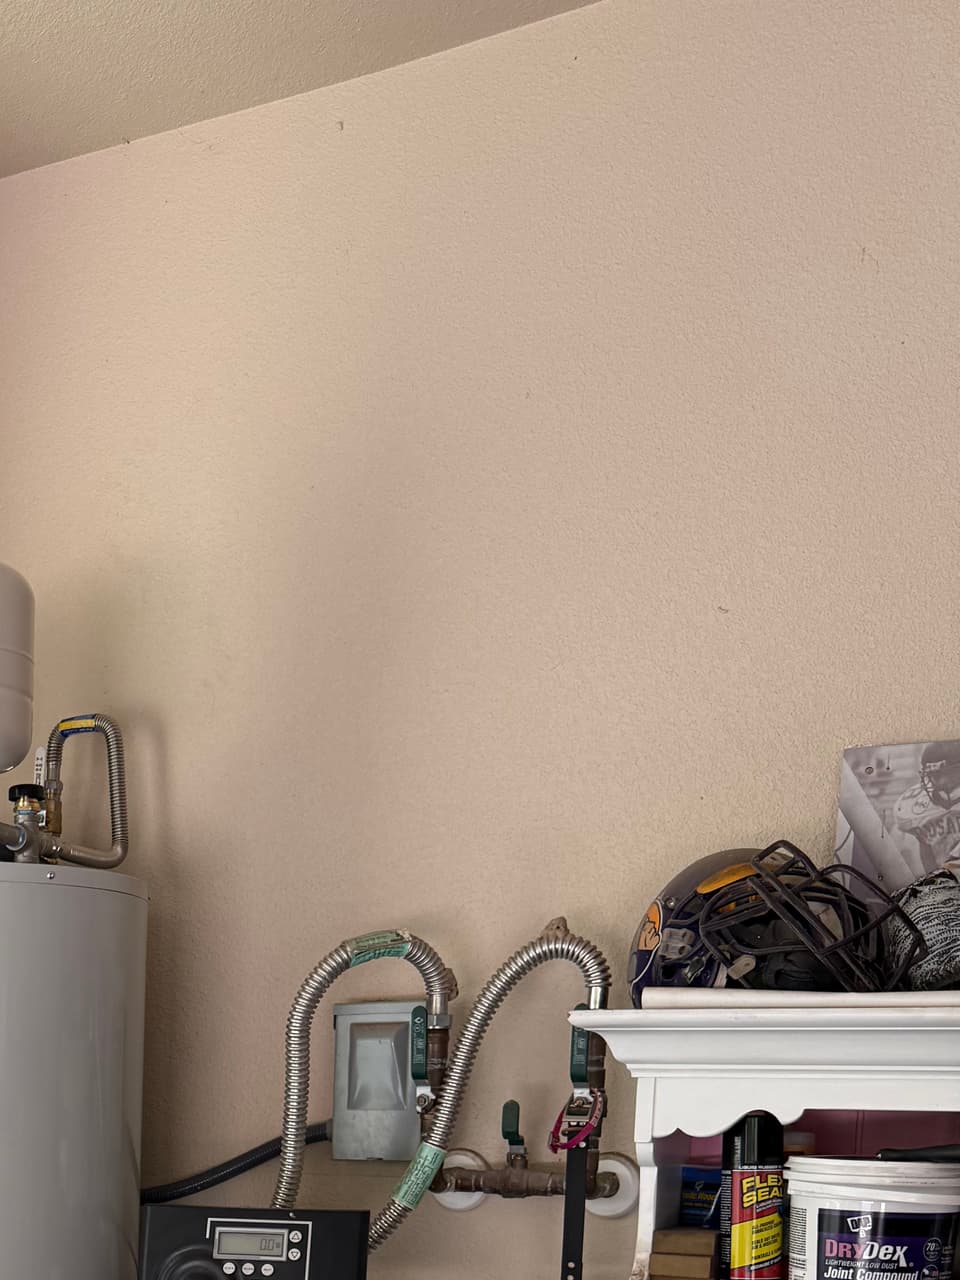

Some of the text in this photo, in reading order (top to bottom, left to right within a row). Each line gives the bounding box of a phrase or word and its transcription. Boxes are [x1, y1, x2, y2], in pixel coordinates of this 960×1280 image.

[825, 1258, 865, 1268] LIGHTWEIGHT
[881, 1262, 898, 1270] DUST
[824, 1266, 854, 1280] Joint
